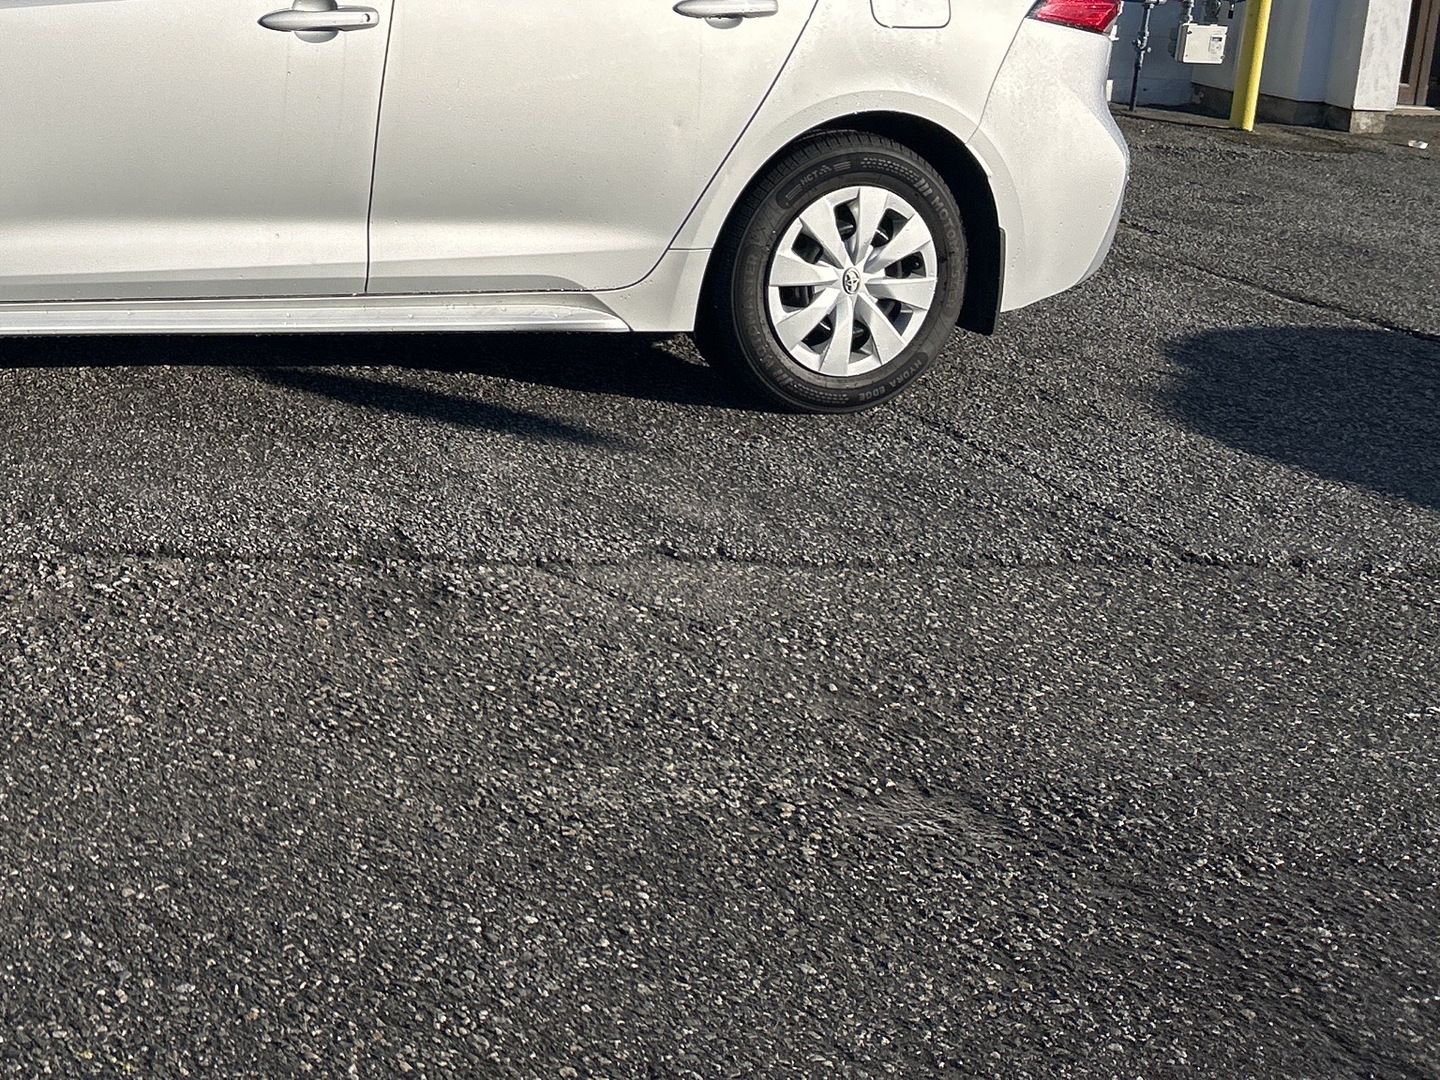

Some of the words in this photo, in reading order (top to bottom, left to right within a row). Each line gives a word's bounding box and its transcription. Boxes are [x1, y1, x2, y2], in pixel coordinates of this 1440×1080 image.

[800, 170, 818, 186] HCT
[889, 359, 923, 388] HYDRA
[859, 386, 886, 401] EDGE
